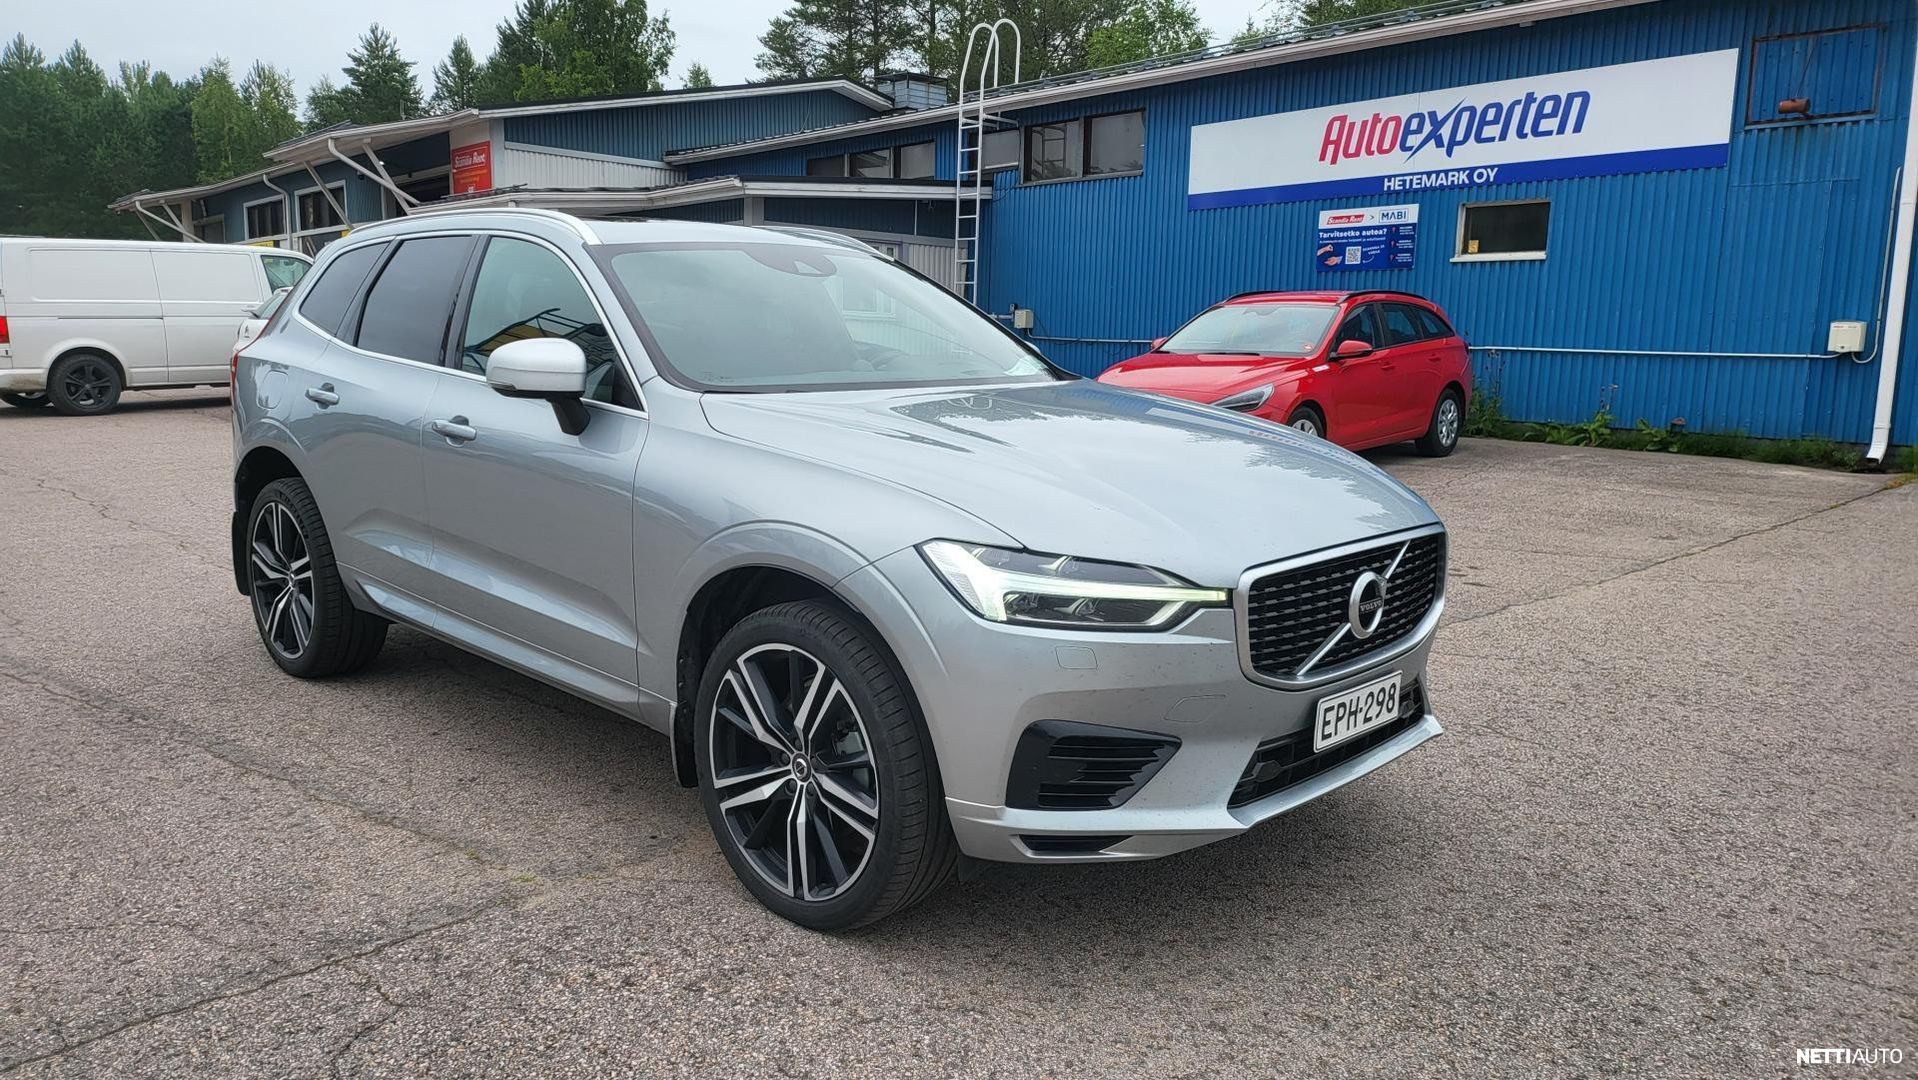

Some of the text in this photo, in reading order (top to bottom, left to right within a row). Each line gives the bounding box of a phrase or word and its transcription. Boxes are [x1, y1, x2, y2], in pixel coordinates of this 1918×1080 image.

[1318, 90, 1591, 165] Autoexperten
[1384, 167, 1499, 191] HETEMARK OY
[1381, 211, 1407, 221] MABI
[1319, 228, 1387, 239] Tarvitsetko autoa?
[1321, 682, 1397, 741] EPH-298
